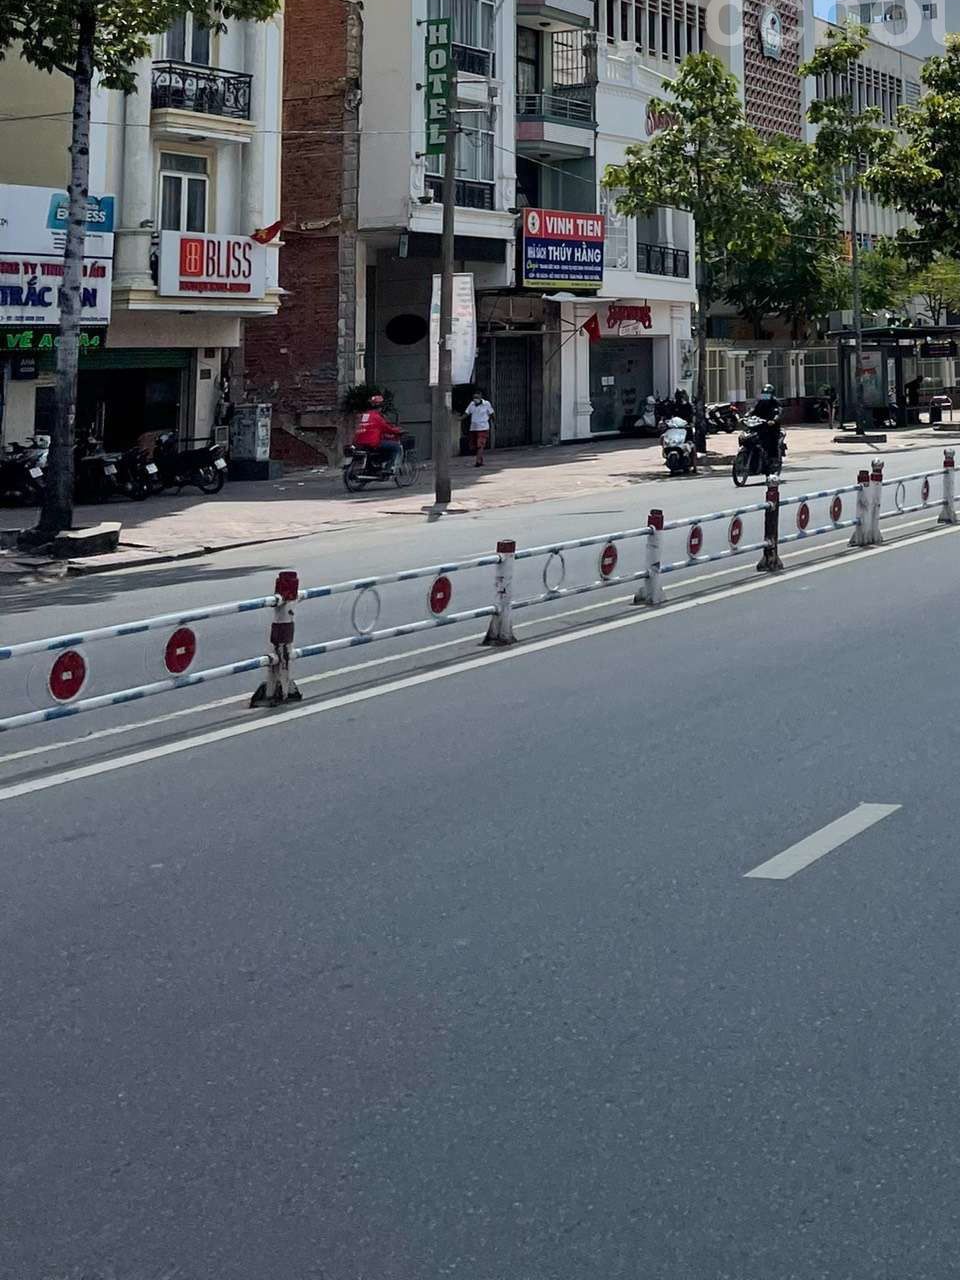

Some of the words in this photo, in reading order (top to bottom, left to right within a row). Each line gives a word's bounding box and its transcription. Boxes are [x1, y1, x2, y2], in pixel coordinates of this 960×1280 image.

[428, 24, 448, 145] HOTEL
[545, 216, 574, 236] VINH
[206, 240, 252, 278] BLISS
